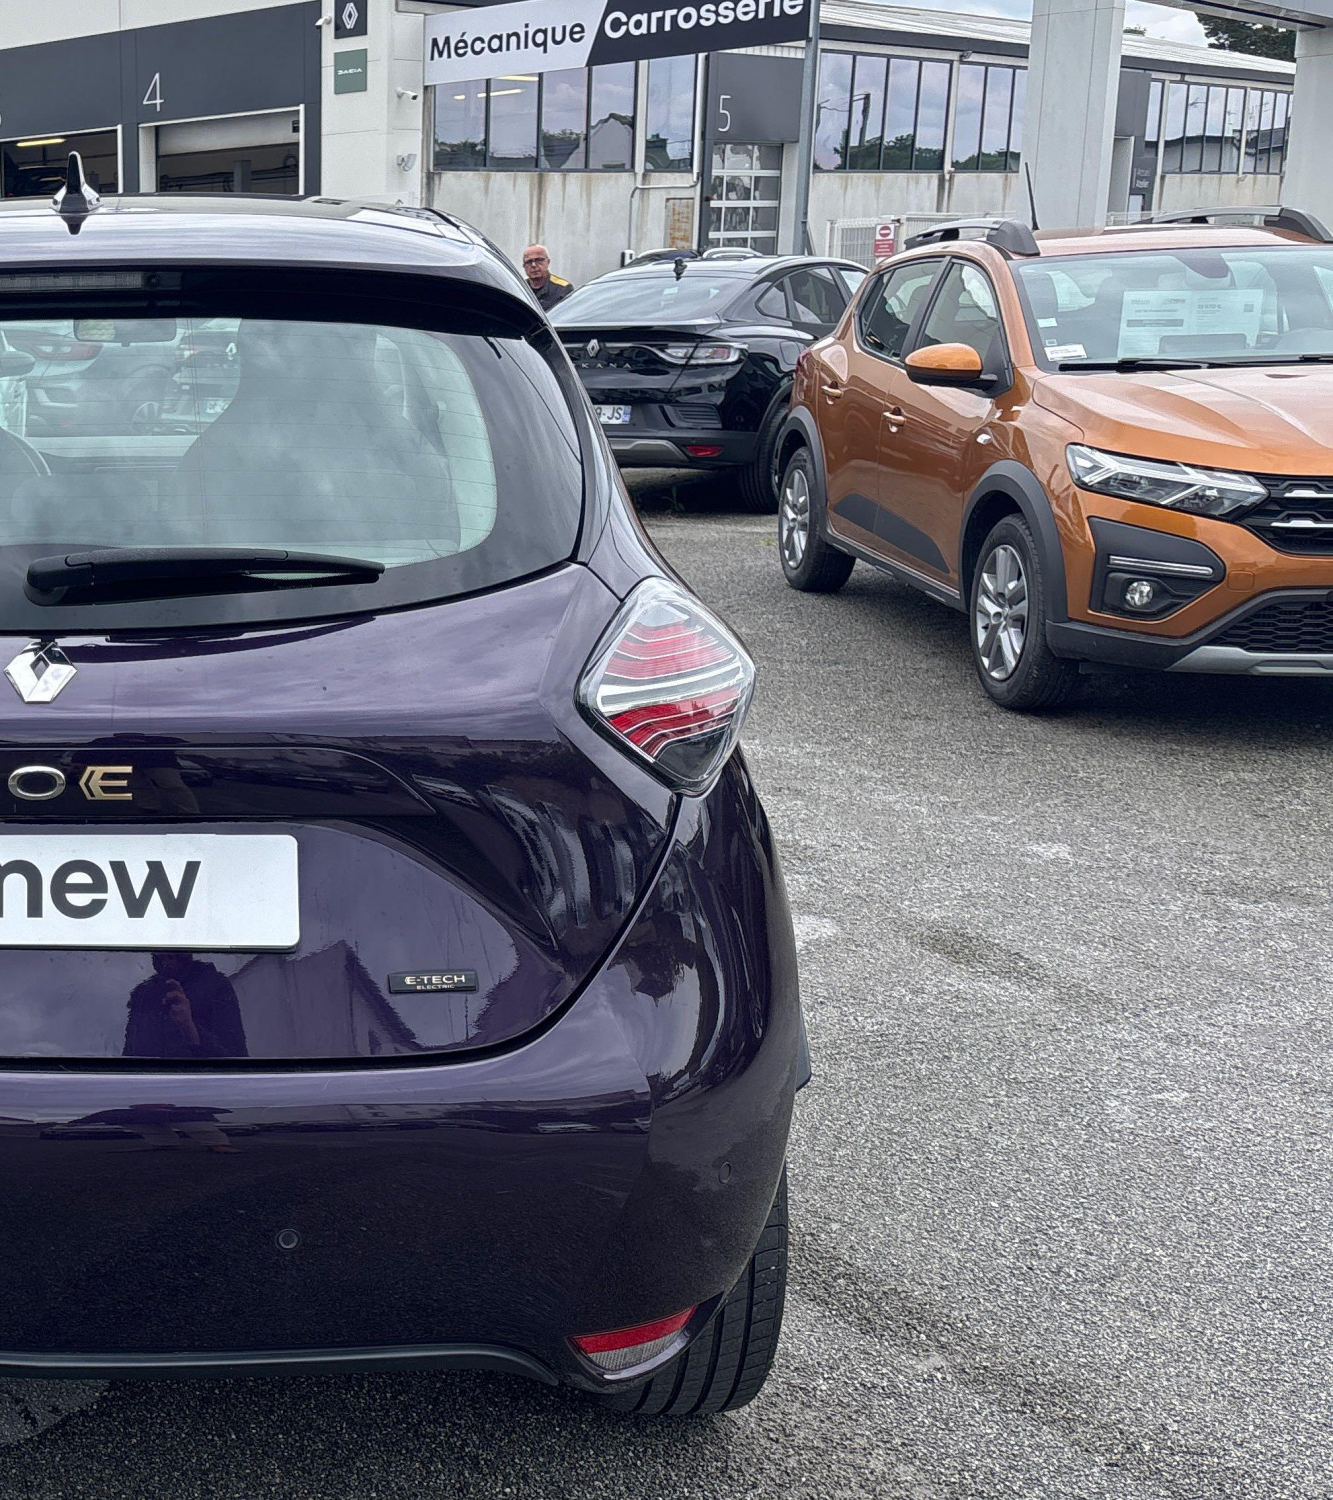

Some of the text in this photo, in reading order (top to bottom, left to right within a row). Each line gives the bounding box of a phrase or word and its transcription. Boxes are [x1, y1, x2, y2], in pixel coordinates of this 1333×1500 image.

[604, 0, 804, 39] Carrosserie
[429, 22, 586, 62] Mécanique
[337, 67, 363, 75] DACIA
[142, 72, 165, 112] 4
[717, 94, 732, 132] 5
[404, 974, 466, 985] E-TECH
